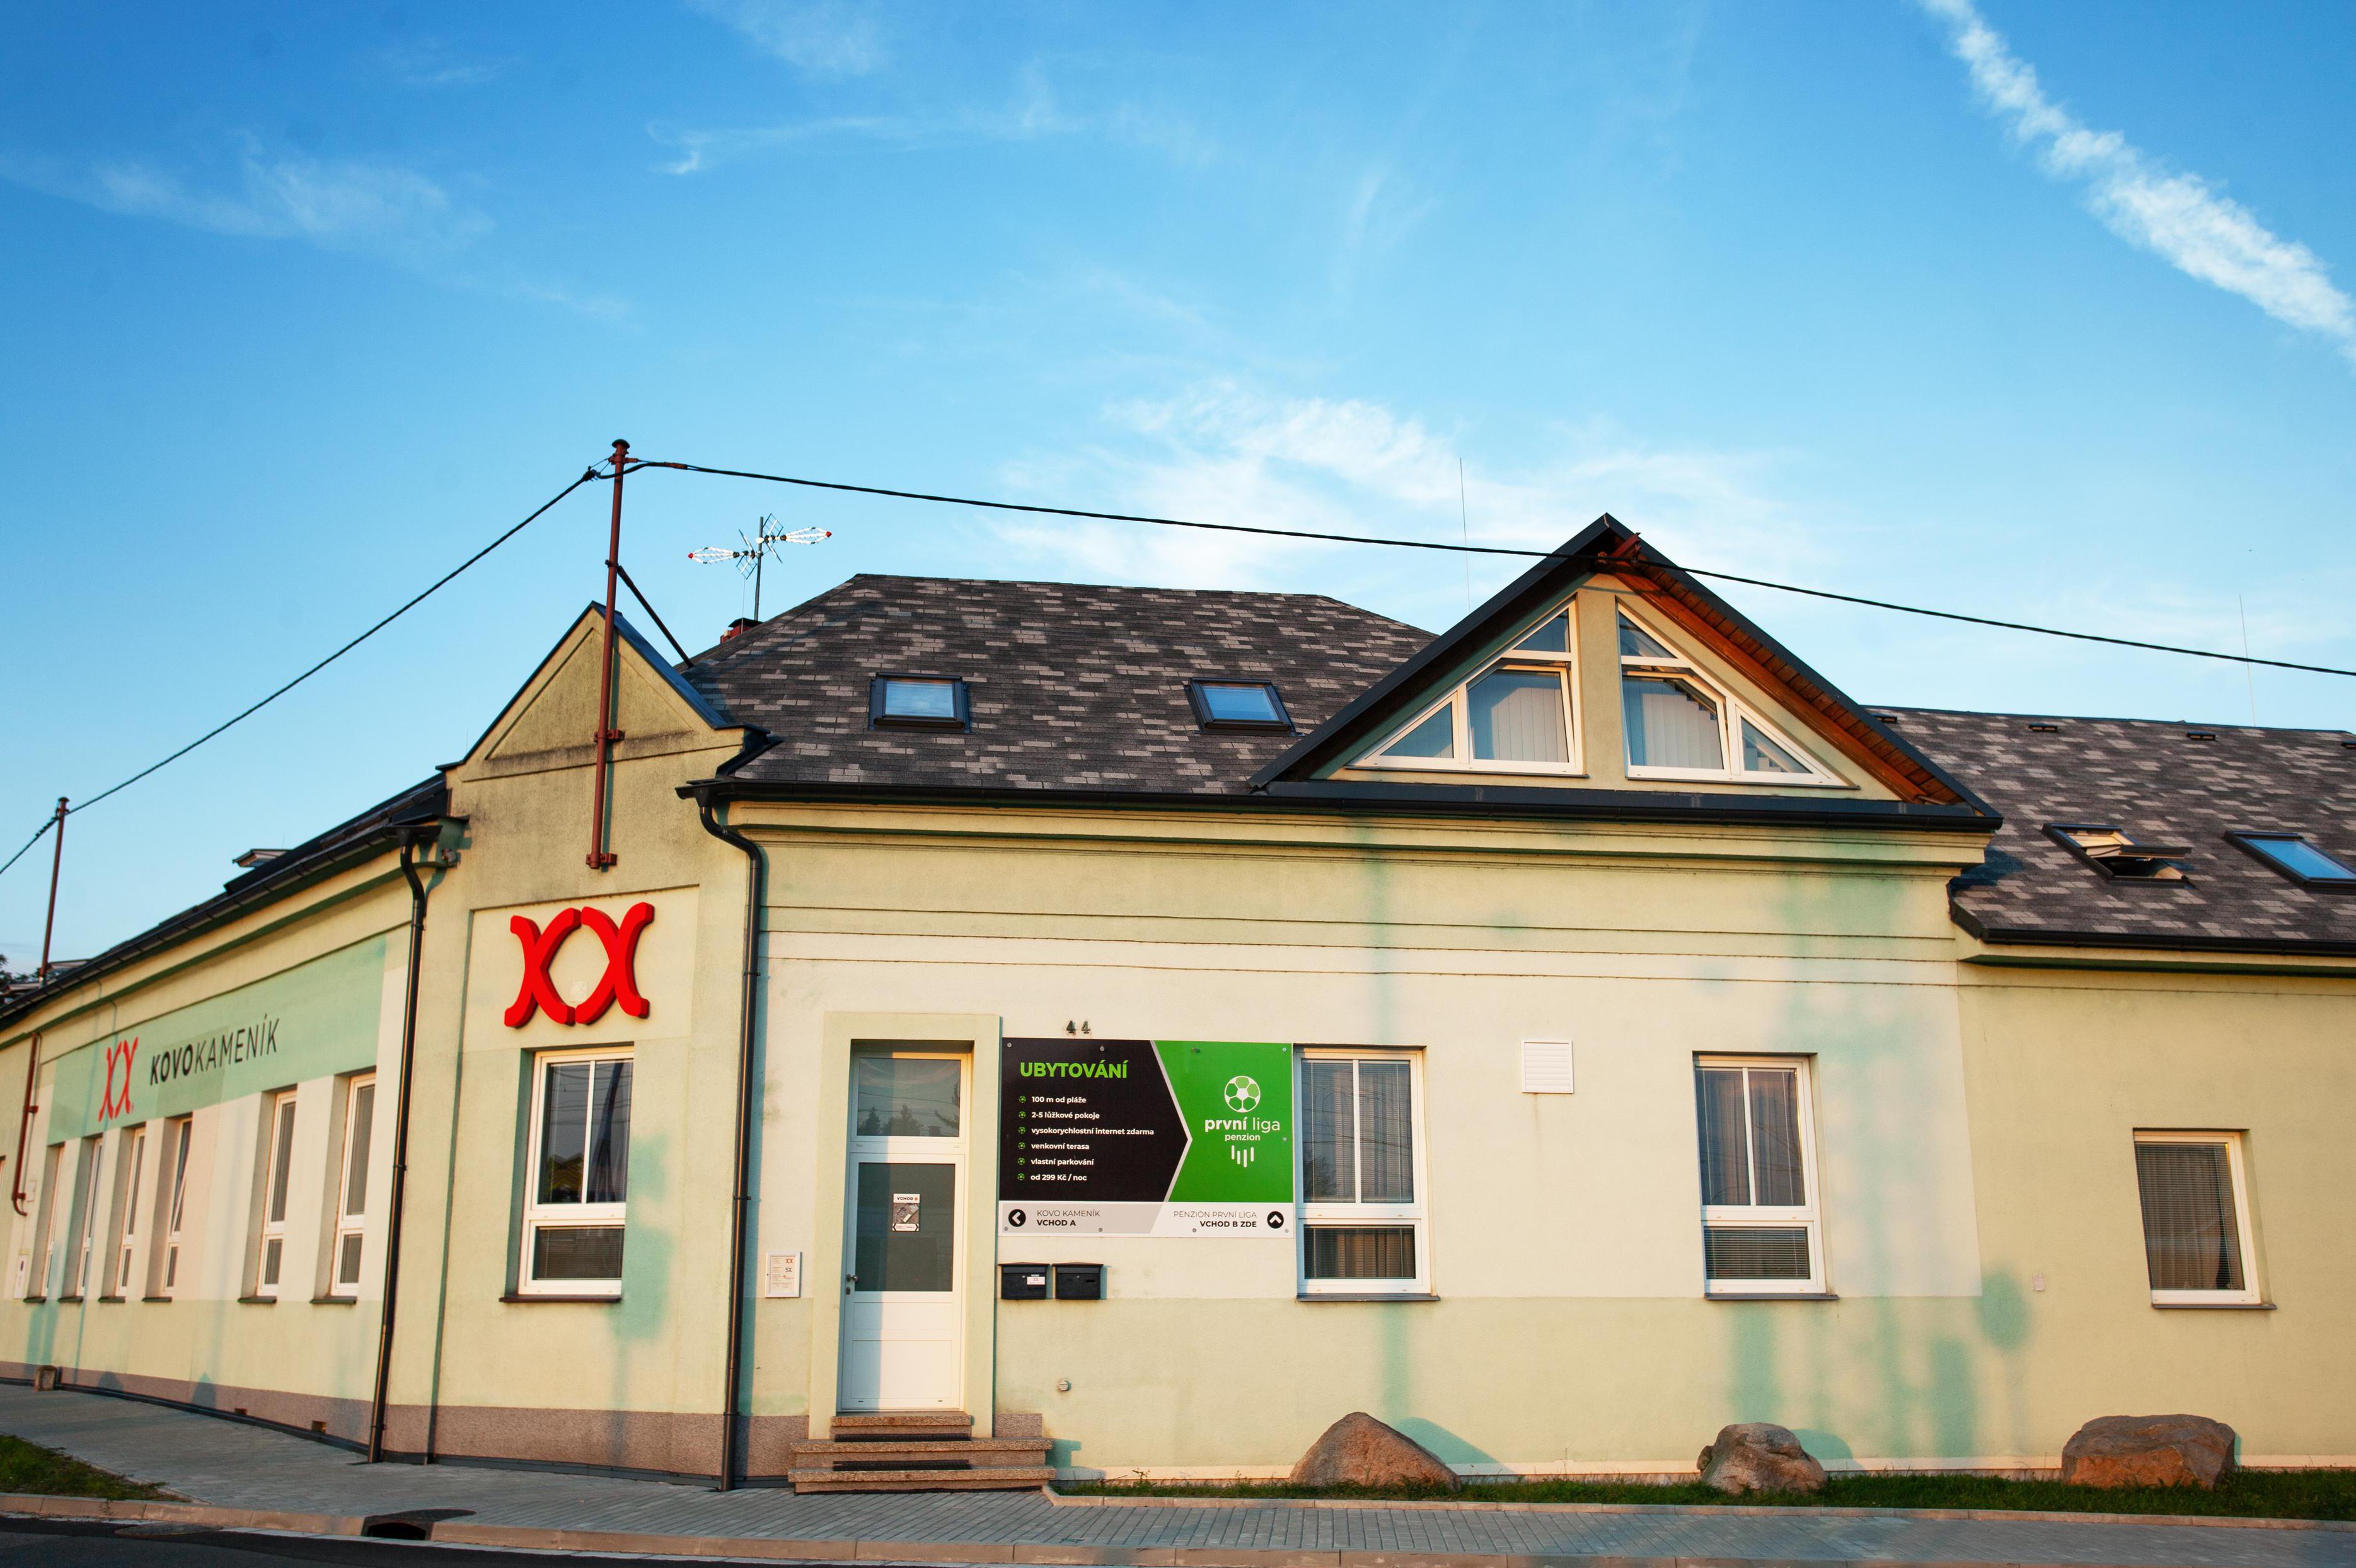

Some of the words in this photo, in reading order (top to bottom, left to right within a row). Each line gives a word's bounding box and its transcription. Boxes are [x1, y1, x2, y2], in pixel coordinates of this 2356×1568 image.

[1020, 1059, 1129, 1078] UBYTOVÁNÍ
[1075, 1112, 1100, 1120] pokoje
[1204, 1116, 1248, 1133] první
[1253, 1117, 1280, 1133] liga
[1031, 1127, 1094, 1135] vysokorychlostní
[1225, 1133, 1261, 1142] penzion
[1057, 1158, 1095, 1167] parkování
